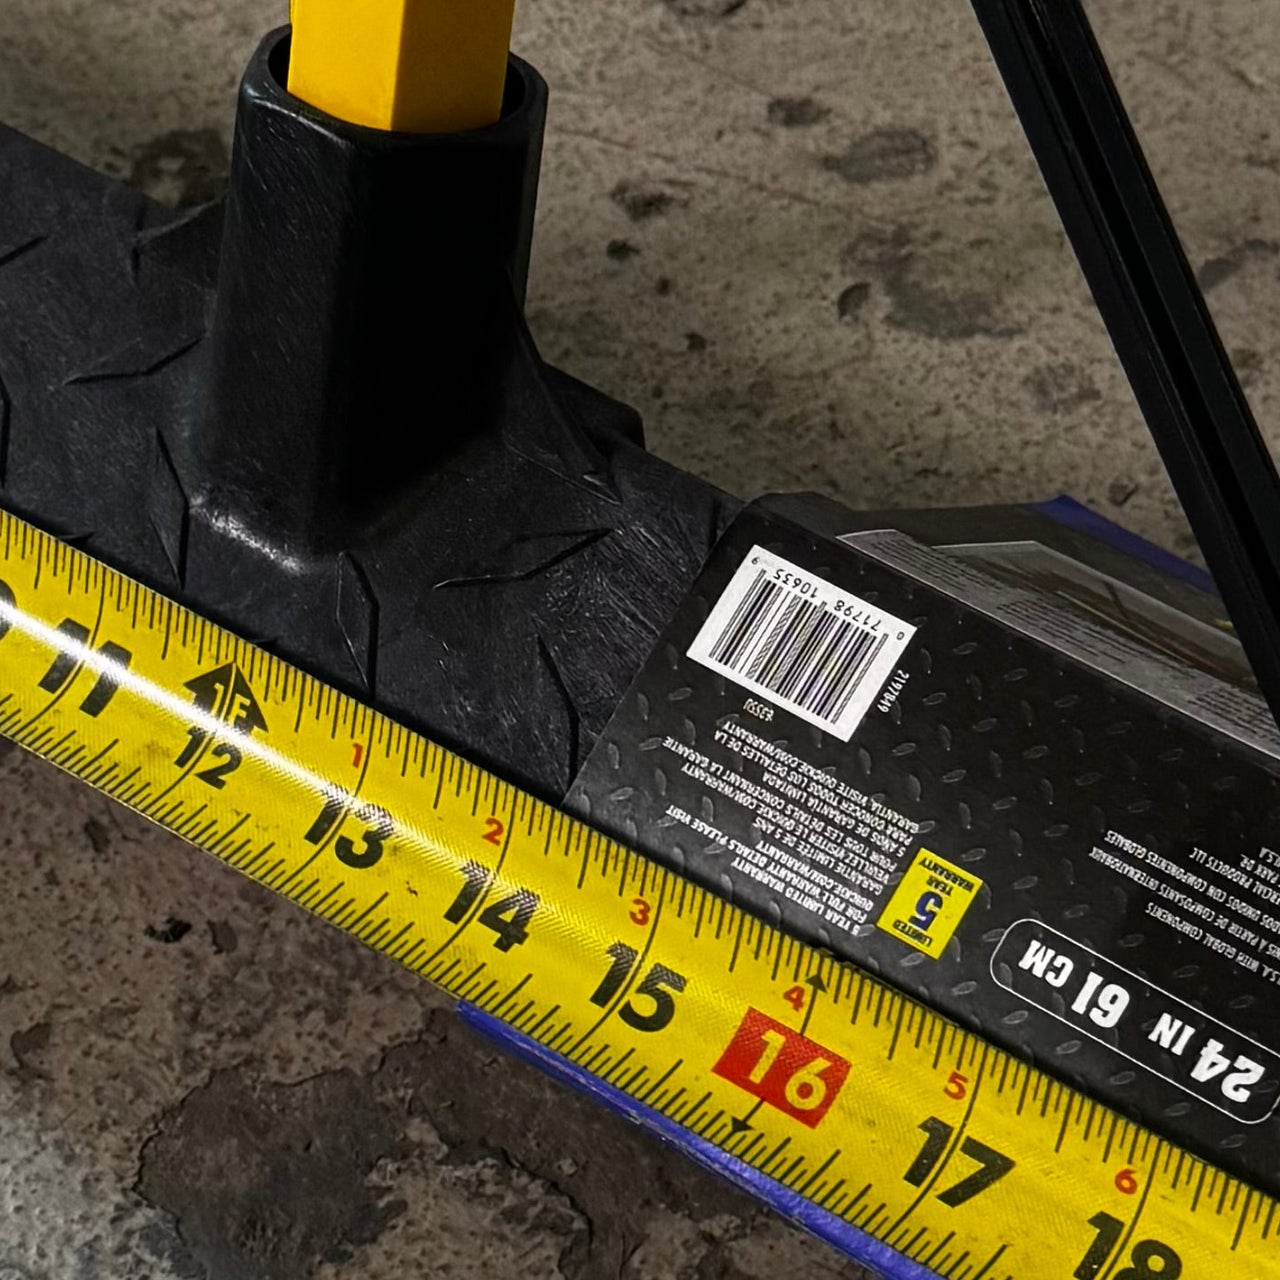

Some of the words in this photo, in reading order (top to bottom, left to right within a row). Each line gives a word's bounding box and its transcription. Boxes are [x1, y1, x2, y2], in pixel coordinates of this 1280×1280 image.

[751, 556, 760, 565] 9
[774, 569, 818, 600] 10635
[834, 600, 880, 632] 71798
[896, 631, 905, 640] 0
[39, 617, 132, 718] 11
[877, 668, 909, 713] 2197849
[713, 729, 726, 743] LA
[726, 737, 741, 750] DE
[173, 724, 244, 790] 12
[352, 742, 364, 768] 1
[662, 736, 709, 767] GARANTIE
[741, 744, 787, 776] DETALLES
[709, 762, 722, 775] LA
[787, 770, 807, 787] LOS
[723, 769, 784, 809] CONCERNANT
[761, 771, 806, 802] LIMITADA
[837, 782, 868, 805] VISITE
[665, 804, 691, 824] VISIT
[753, 816, 775, 834] ANS
[840, 799, 885, 829] CONOCER
[303, 785, 394, 870] 13
[481, 817, 505, 846] 2
[691, 819, 727, 844] PLEASE
[774, 828, 782, 837] 5
[781, 832, 796, 846] DE
[794, 823, 808, 837] LE
[824, 825, 843, 841] LES
[854, 822, 870, 836] DE
[885, 824, 912, 845] PARA
[728, 839, 766, 866] DETAILS
[808, 832, 845, 858] VISITER
[843, 836, 869, 856] TOUS
[897, 846, 905, 857] 5
[1104, 829, 1146, 858] GLOBALES
[1189, 847, 1206, 863] LLC
[869, 850, 896, 870] POUR
[1145, 851, 1207, 891] COMPONENTES
[1205, 856, 1252, 888] PRODUCTS
[1254, 863, 1279, 883] PARK
[731, 856, 785, 891] WARRANTY
[767, 861, 820, 896] WARRANTY
[835, 862, 882, 894] GARANTIE
[920, 858, 974, 890] WARRANTY
[926, 877, 953, 896] YEAR
[442, 858, 540, 954] 14
[784, 886, 823, 914] LIMITED
[820, 891, 845, 910] FULL
[1157, 884, 1215, 921] COMPOSANTS
[1206, 885, 1226, 902] CON
[629, 898, 651, 926] 3
[824, 909, 850, 929] YEAR
[846, 905, 866, 922] FOR
[913, 892, 943, 930] 5
[1145, 902, 1202, 939] COMPONENTS
[1226, 895, 1260, 920] UNIDOS
[851, 924, 860, 934] 5
[894, 920, 933, 946] LIMITED
[1214, 914, 1228, 928] DE
[1227, 922, 1258, 945] PARTIR
[1201, 933, 1236, 958] GLOBAL
[1019, 940, 1071, 988] CM
[1235, 952, 1259, 971] WITH
[589, 940, 688, 1034] 15
[782, 985, 805, 1012] 4
[1071, 971, 1131, 1028] 61
[1148, 1013, 1194, 1054] IN
[747, 1029, 829, 1111] 16
[1190, 1038, 1266, 1103] 24
[943, 1070, 969, 1101] 5
[902, 1115, 1016, 1209] 17
[1114, 1169, 1138, 1195] 6
